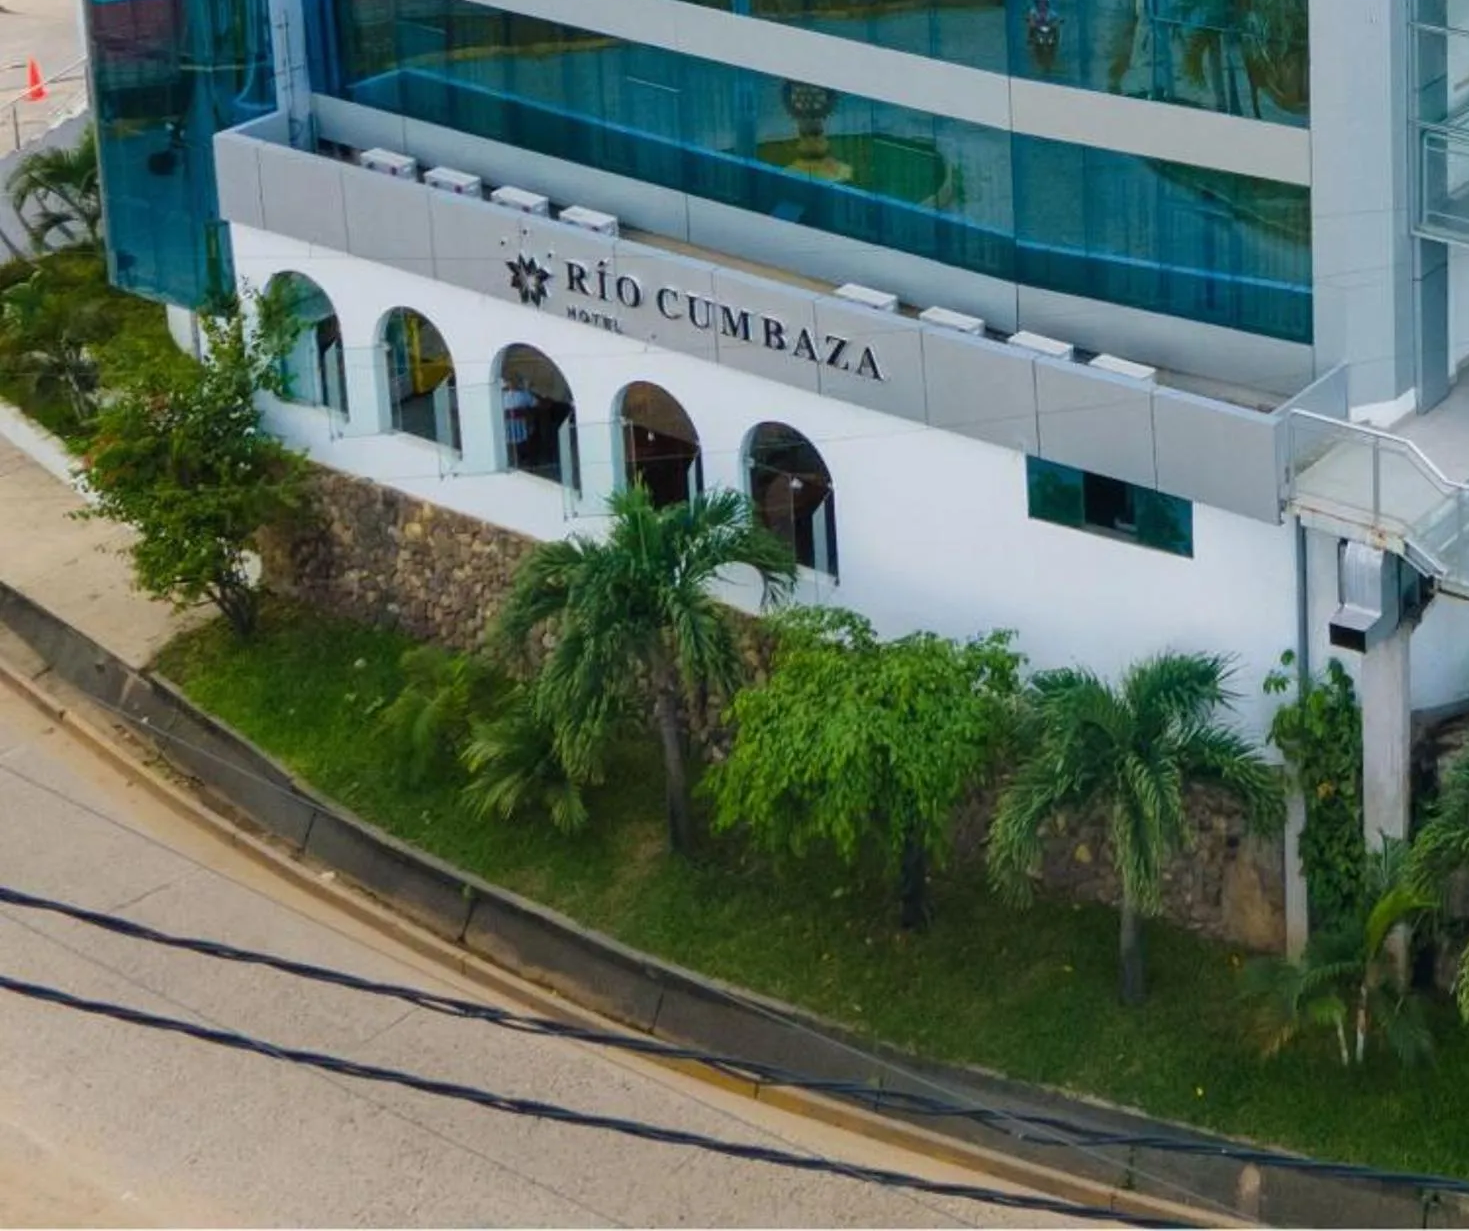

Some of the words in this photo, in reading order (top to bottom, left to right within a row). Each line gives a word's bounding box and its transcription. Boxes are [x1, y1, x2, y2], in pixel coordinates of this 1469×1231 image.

[566, 305, 623, 335] HOTEL
[566, 260, 642, 309] RÍO
[656, 288, 885, 381] CUMBAZA
